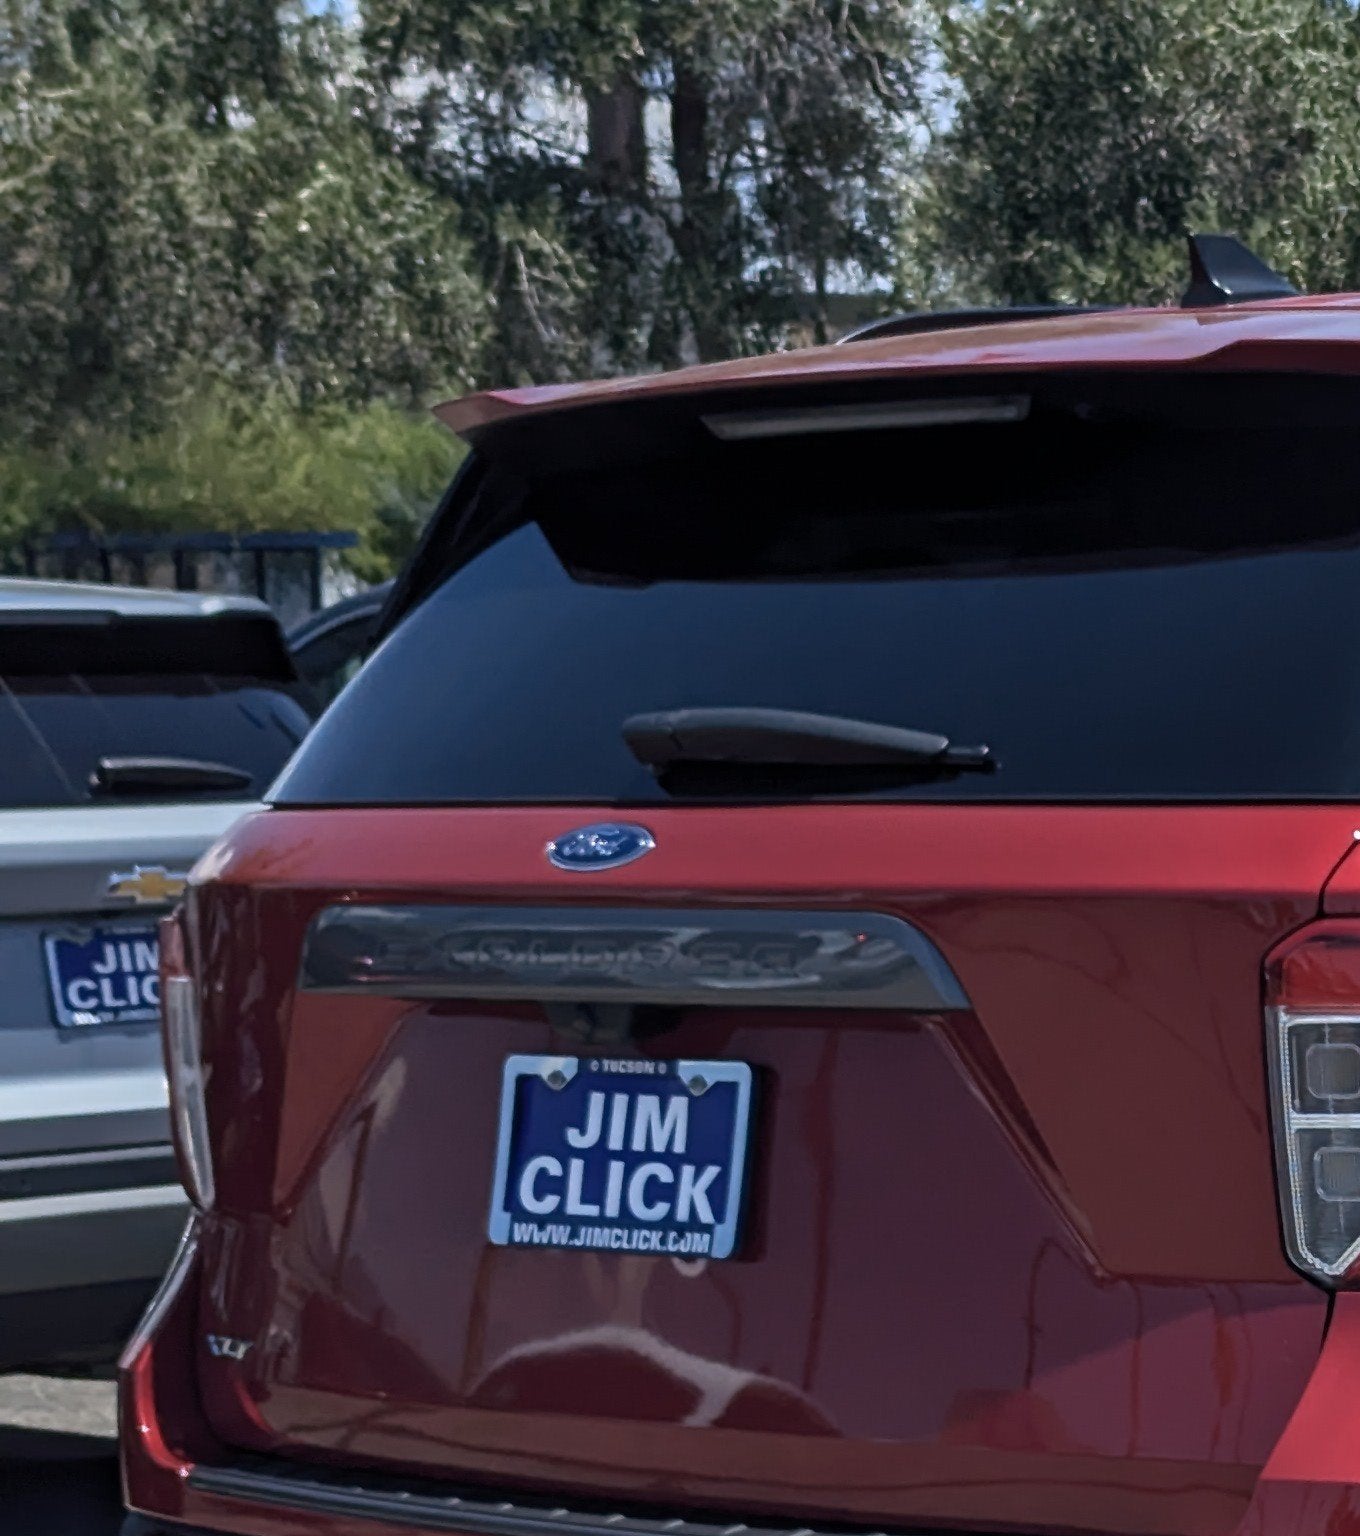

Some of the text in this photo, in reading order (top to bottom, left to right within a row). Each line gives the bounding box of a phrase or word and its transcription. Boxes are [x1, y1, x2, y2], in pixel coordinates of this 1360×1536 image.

[566, 1091, 689, 1153] JIM
[519, 1155, 722, 1224] CLICK
[514, 1222, 711, 1253] WWW.JIMCLICK.COM
